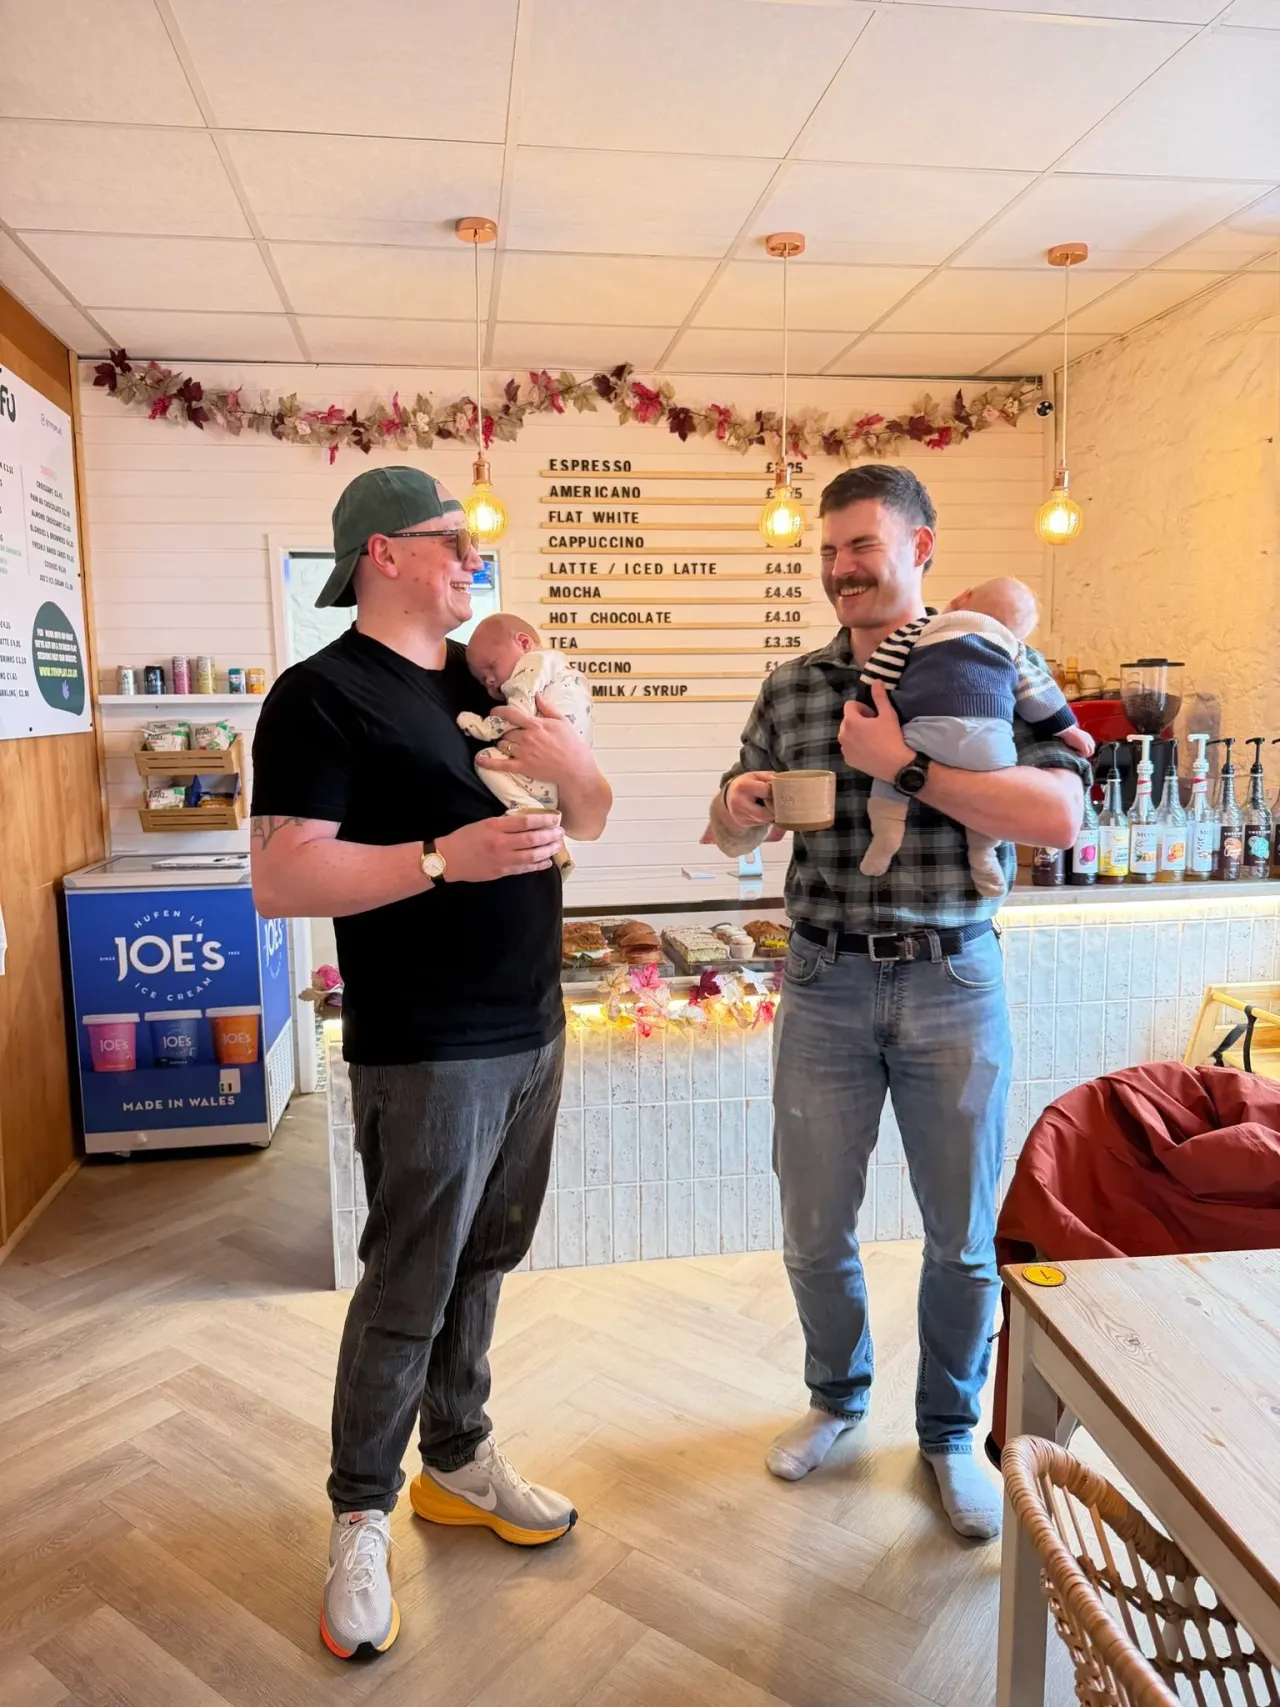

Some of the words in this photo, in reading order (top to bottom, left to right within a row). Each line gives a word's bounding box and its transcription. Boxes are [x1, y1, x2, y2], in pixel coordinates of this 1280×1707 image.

[549, 459, 632, 472] ESPRESSO
[549, 486, 641, 499] AMERICANO
[549, 511, 582, 523] FLAT
[593, 512, 639, 524] WHITE
[549, 536, 644, 548] CAPPUCCINO
[549, 562, 598, 575] LATTE
[608, 563, 616, 574] /
[624, 563, 663, 575] ICED
[673, 563, 717, 575] LATTE
[765, 563, 802, 575] £4.10
[549, 586, 602, 598] MOCHA
[765, 587, 802, 598] £4.45
[549, 612, 578, 624] HOT
[590, 612, 672, 624] CHOCOLATE
[764, 611, 801, 623] £4.10
[550, 637, 578, 649] TEA
[764, 637, 801, 648] £3.35
[569, 661, 631, 674] FUCCINO
[592, 684, 625, 697] MILK
[631, 685, 638, 697] /
[643, 685, 688, 697] SYRUP
[134, 909, 181, 928] HUFEN
[264, 918, 283, 967] JOES
[114, 933, 226, 982] JOE'S
[135, 982, 157, 1000] ICE
[167, 977, 212, 1002] CREAM
[123, 1098, 163, 1112] MADE
[168, 1098, 183, 1110] IN
[189, 1095, 235, 1109] WALES
